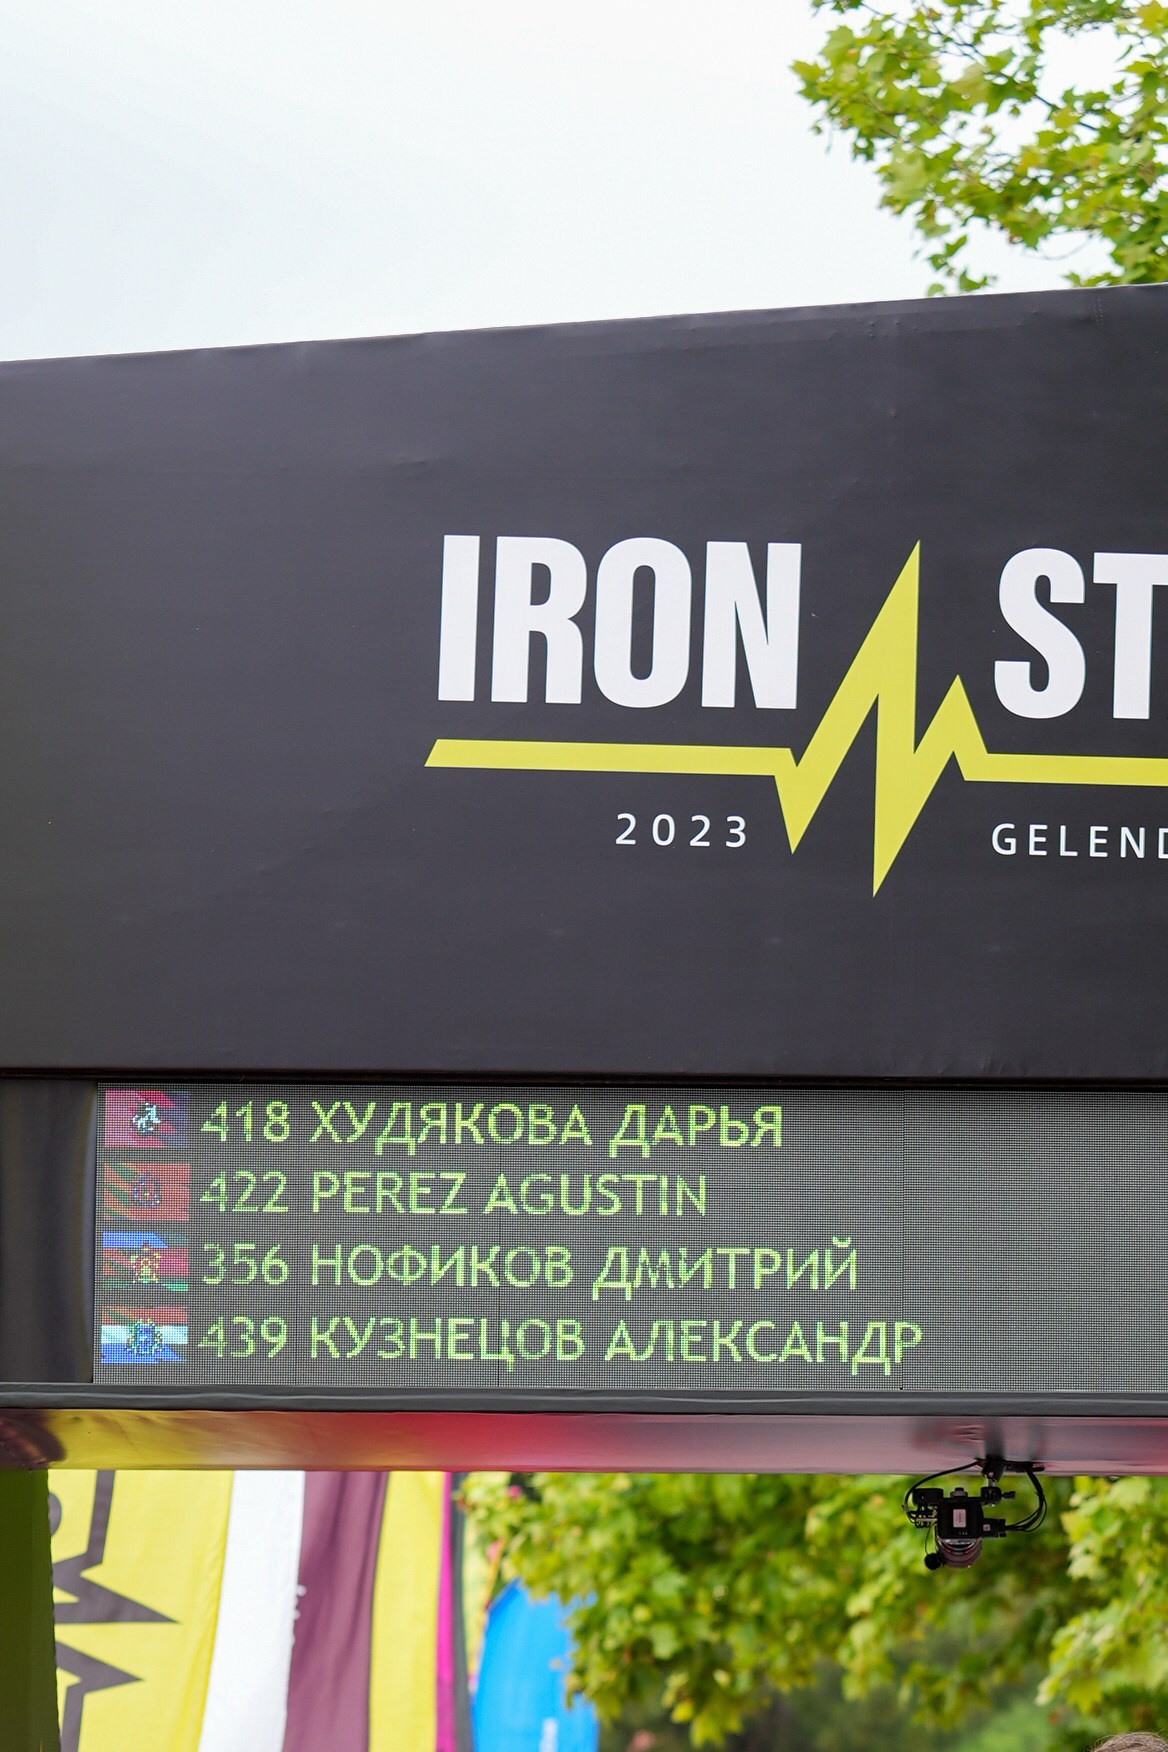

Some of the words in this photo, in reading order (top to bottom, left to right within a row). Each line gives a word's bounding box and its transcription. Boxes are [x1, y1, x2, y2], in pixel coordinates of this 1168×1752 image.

[438, 534, 801, 709] IRON
[614, 812, 748, 848] 2023
[199, 1100, 291, 1144] 418
[310, 1102, 592, 1155] ХУДЯКОВА
[608, 1104, 784, 1158] ДАРЬЯ
[199, 1171, 290, 1214] 422
[311, 1172, 467, 1214] PEREZ
[482, 1174, 707, 1217] AGUSTIN
[200, 1243, 289, 1286] 356
[311, 1244, 573, 1288] НОФИКОВ
[592, 1236, 858, 1301] ДМИТРИЙ
[197, 1315, 289, 1359] 439
[311, 1317, 586, 1373] КУЗНЕЦОВ
[604, 1320, 923, 1376] АЛЕКСАНДР
